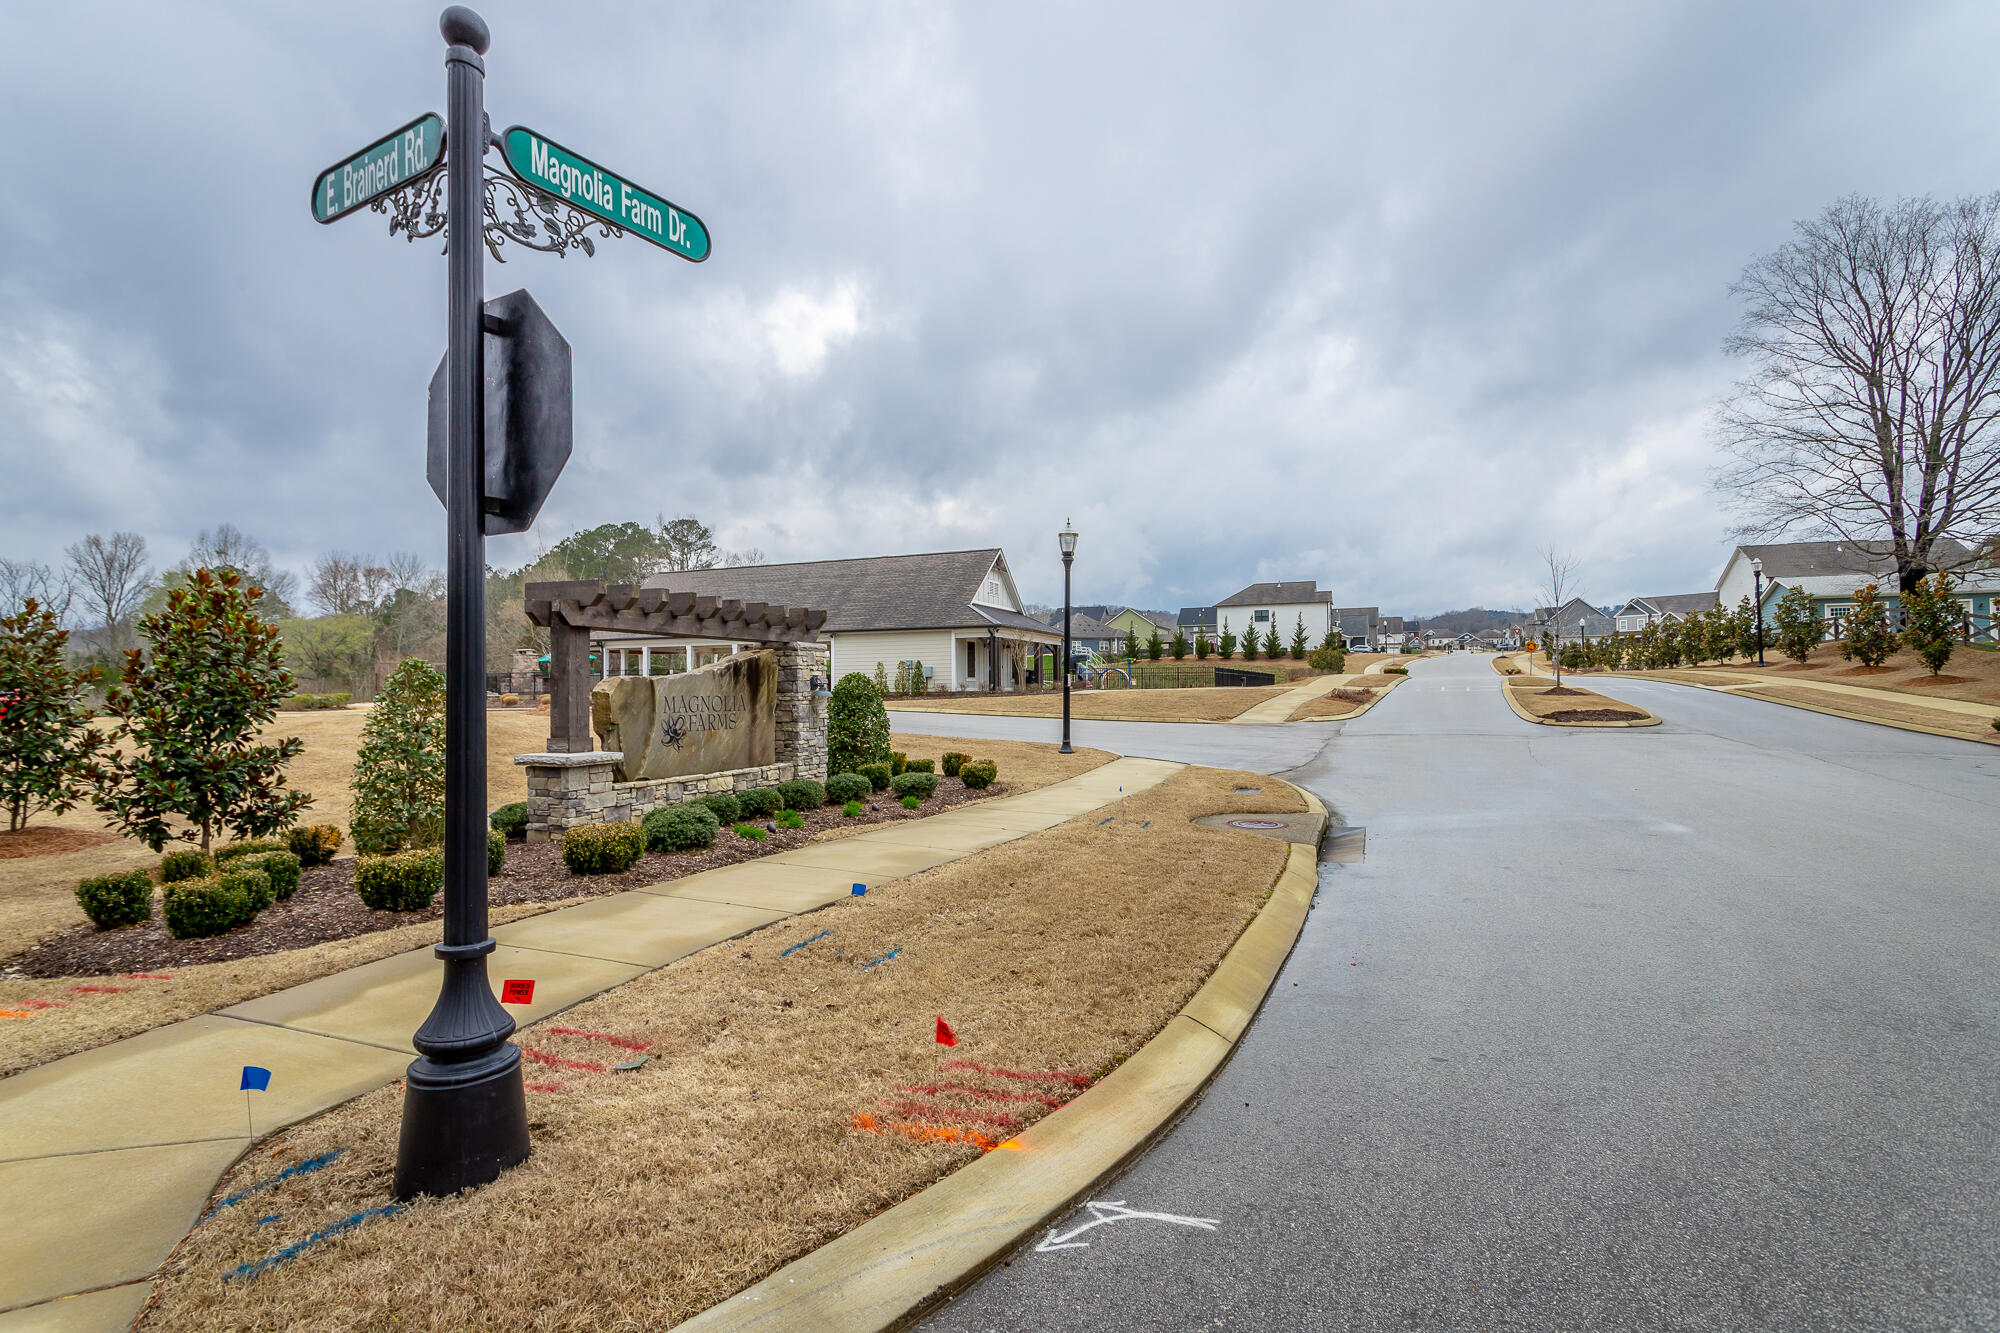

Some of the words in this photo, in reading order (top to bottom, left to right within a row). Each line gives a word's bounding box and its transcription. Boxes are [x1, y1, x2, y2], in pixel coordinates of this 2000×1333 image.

[326, 172, 338, 216] E.
[344, 139, 398, 207] Brainerd
[405, 125, 427, 176] Rd.
[531, 136, 613, 211] Magnolia
[621, 183, 662, 235] Farm
[668, 207, 690, 249] Dr.
[663, 694, 746, 714] MAGNOLIA
[688, 712, 737, 732] FARMS
